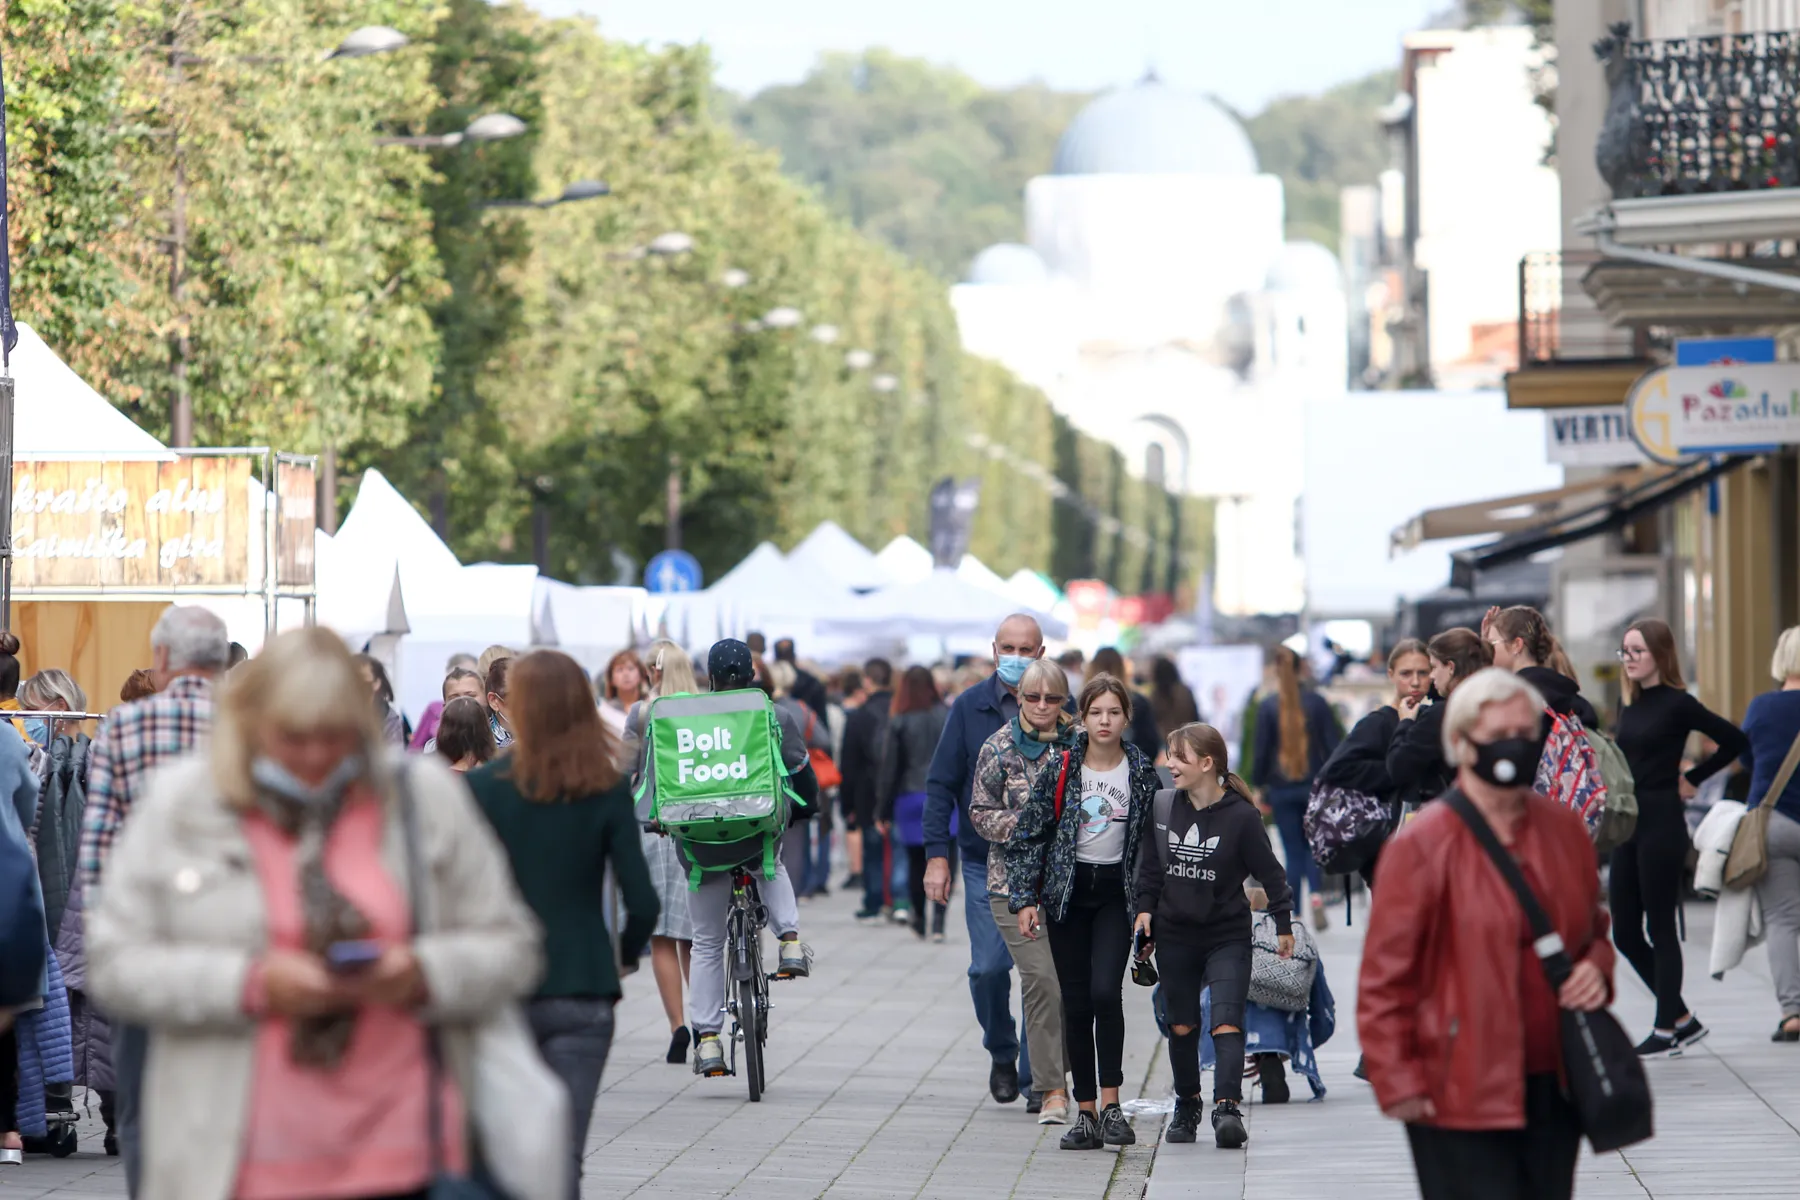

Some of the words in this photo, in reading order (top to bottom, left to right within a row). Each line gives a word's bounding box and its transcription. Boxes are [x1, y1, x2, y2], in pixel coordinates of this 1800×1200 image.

[676, 726, 732, 756] Bolt
[678, 754, 748, 784] Food
[1096, 781, 1109, 792] MY
[1108, 785, 1130, 808] WORLD
[1165, 862, 1216, 882] adidas
